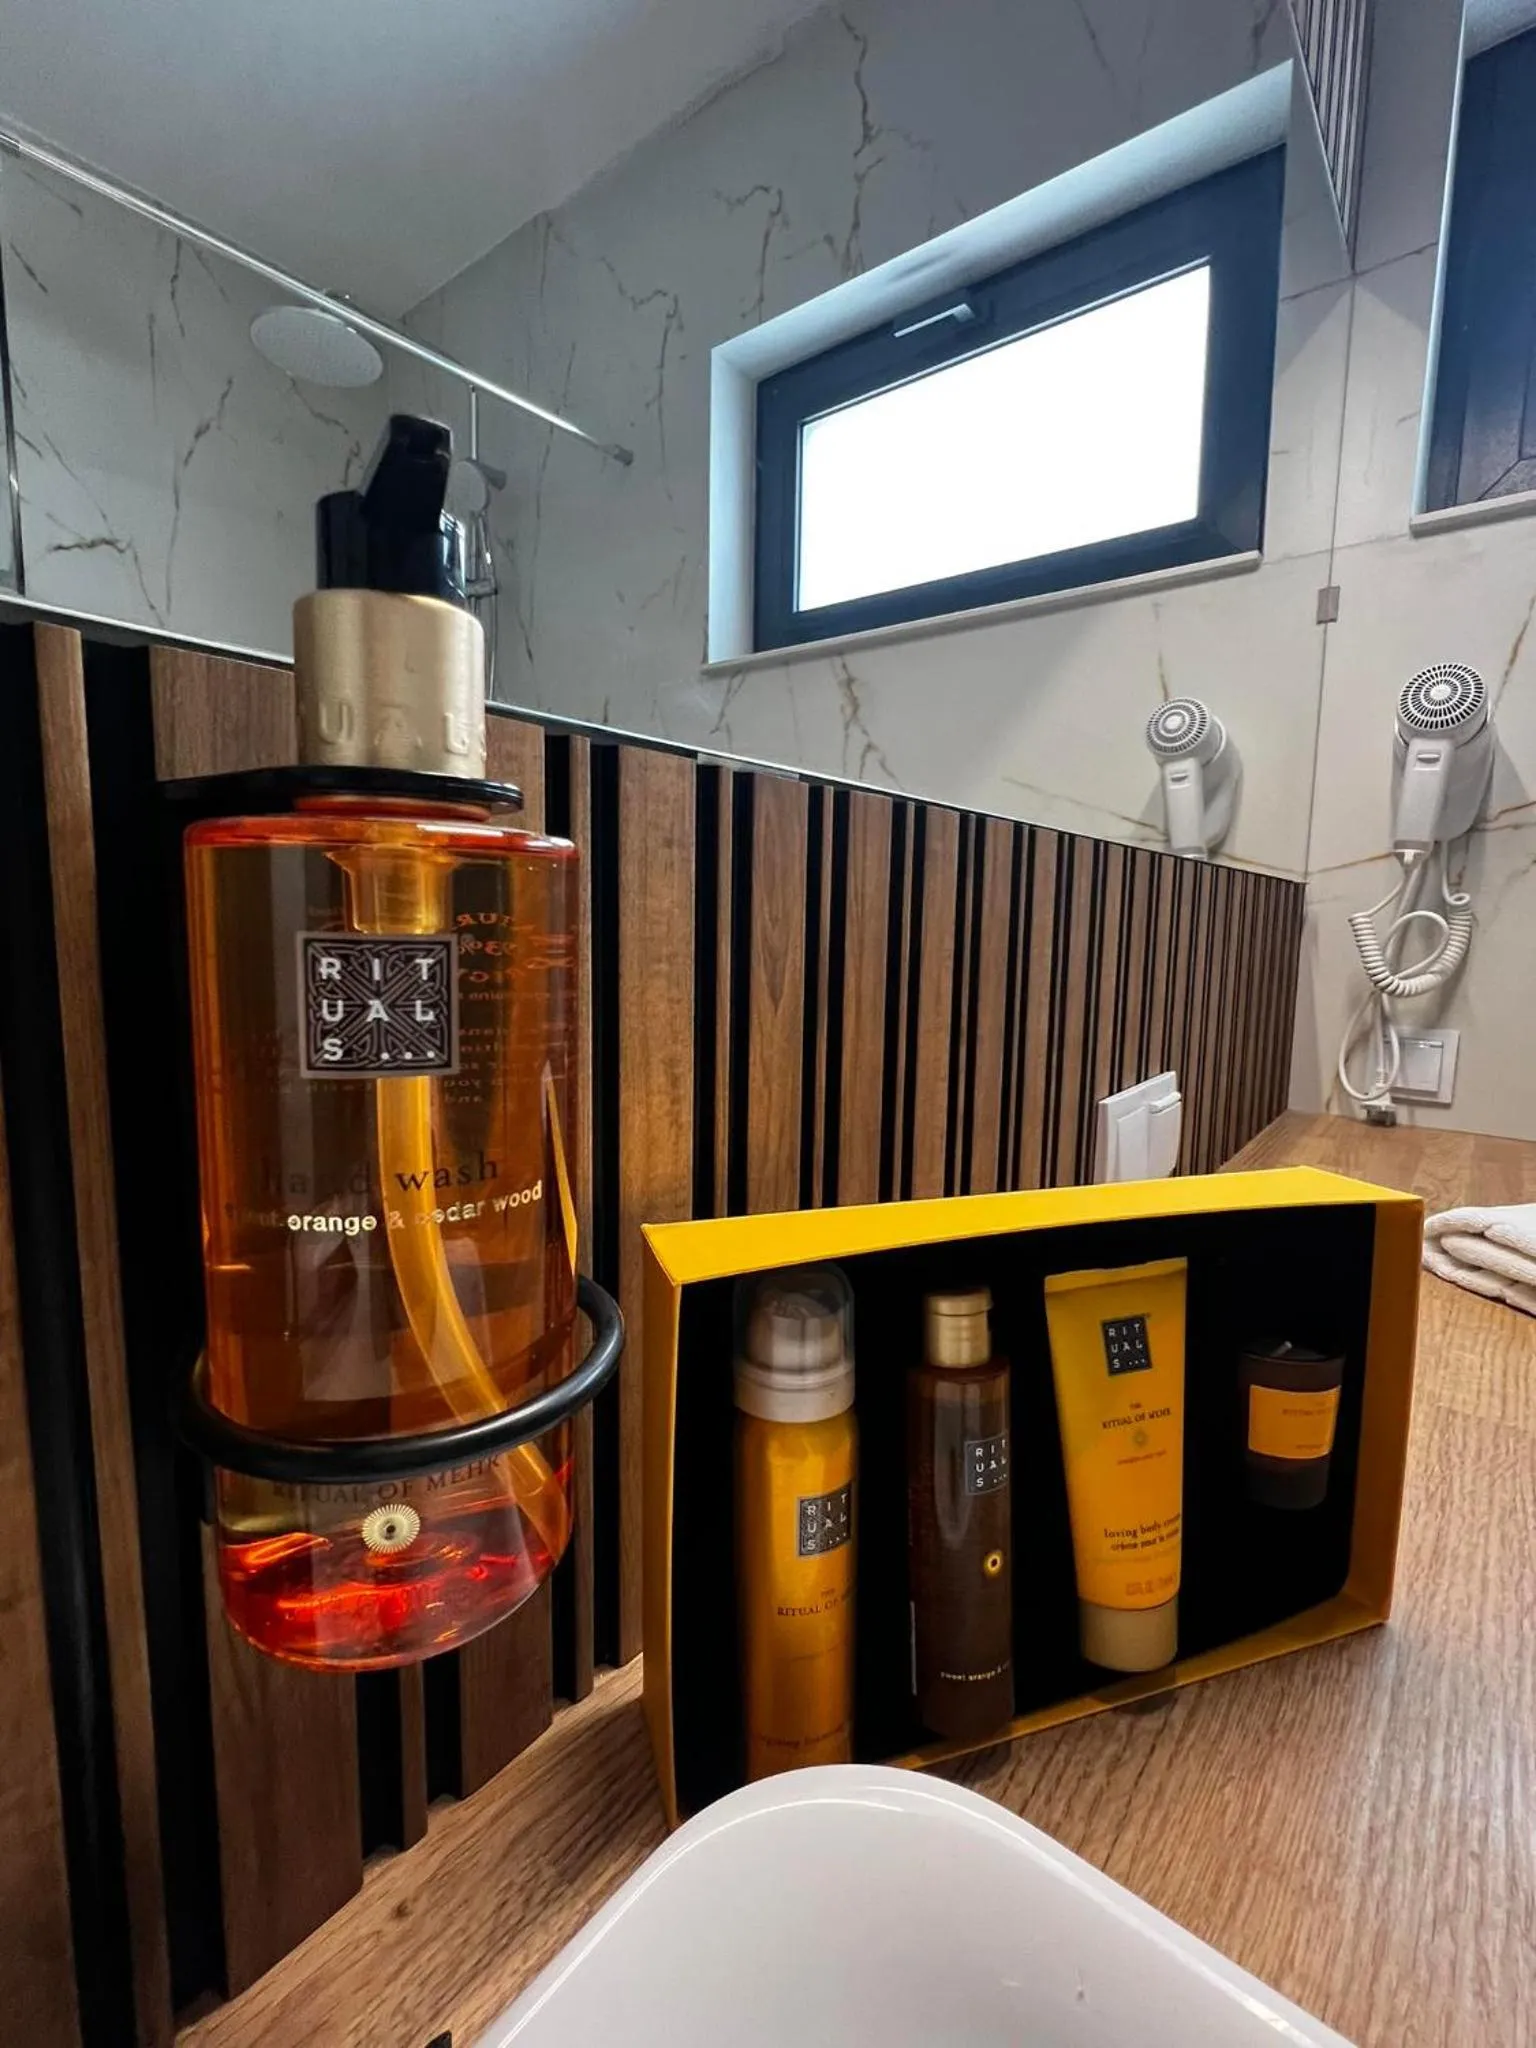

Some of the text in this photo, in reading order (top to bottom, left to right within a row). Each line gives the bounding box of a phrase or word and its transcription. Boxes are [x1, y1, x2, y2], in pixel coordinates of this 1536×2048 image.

[261, 1150, 498, 1194] had wash
[287, 1214, 377, 1236] orange
[388, 1209, 405, 1230] &
[492, 1179, 543, 1213] wood
[272, 1481, 366, 1504] RITUAL
[377, 1479, 414, 1500] OF
